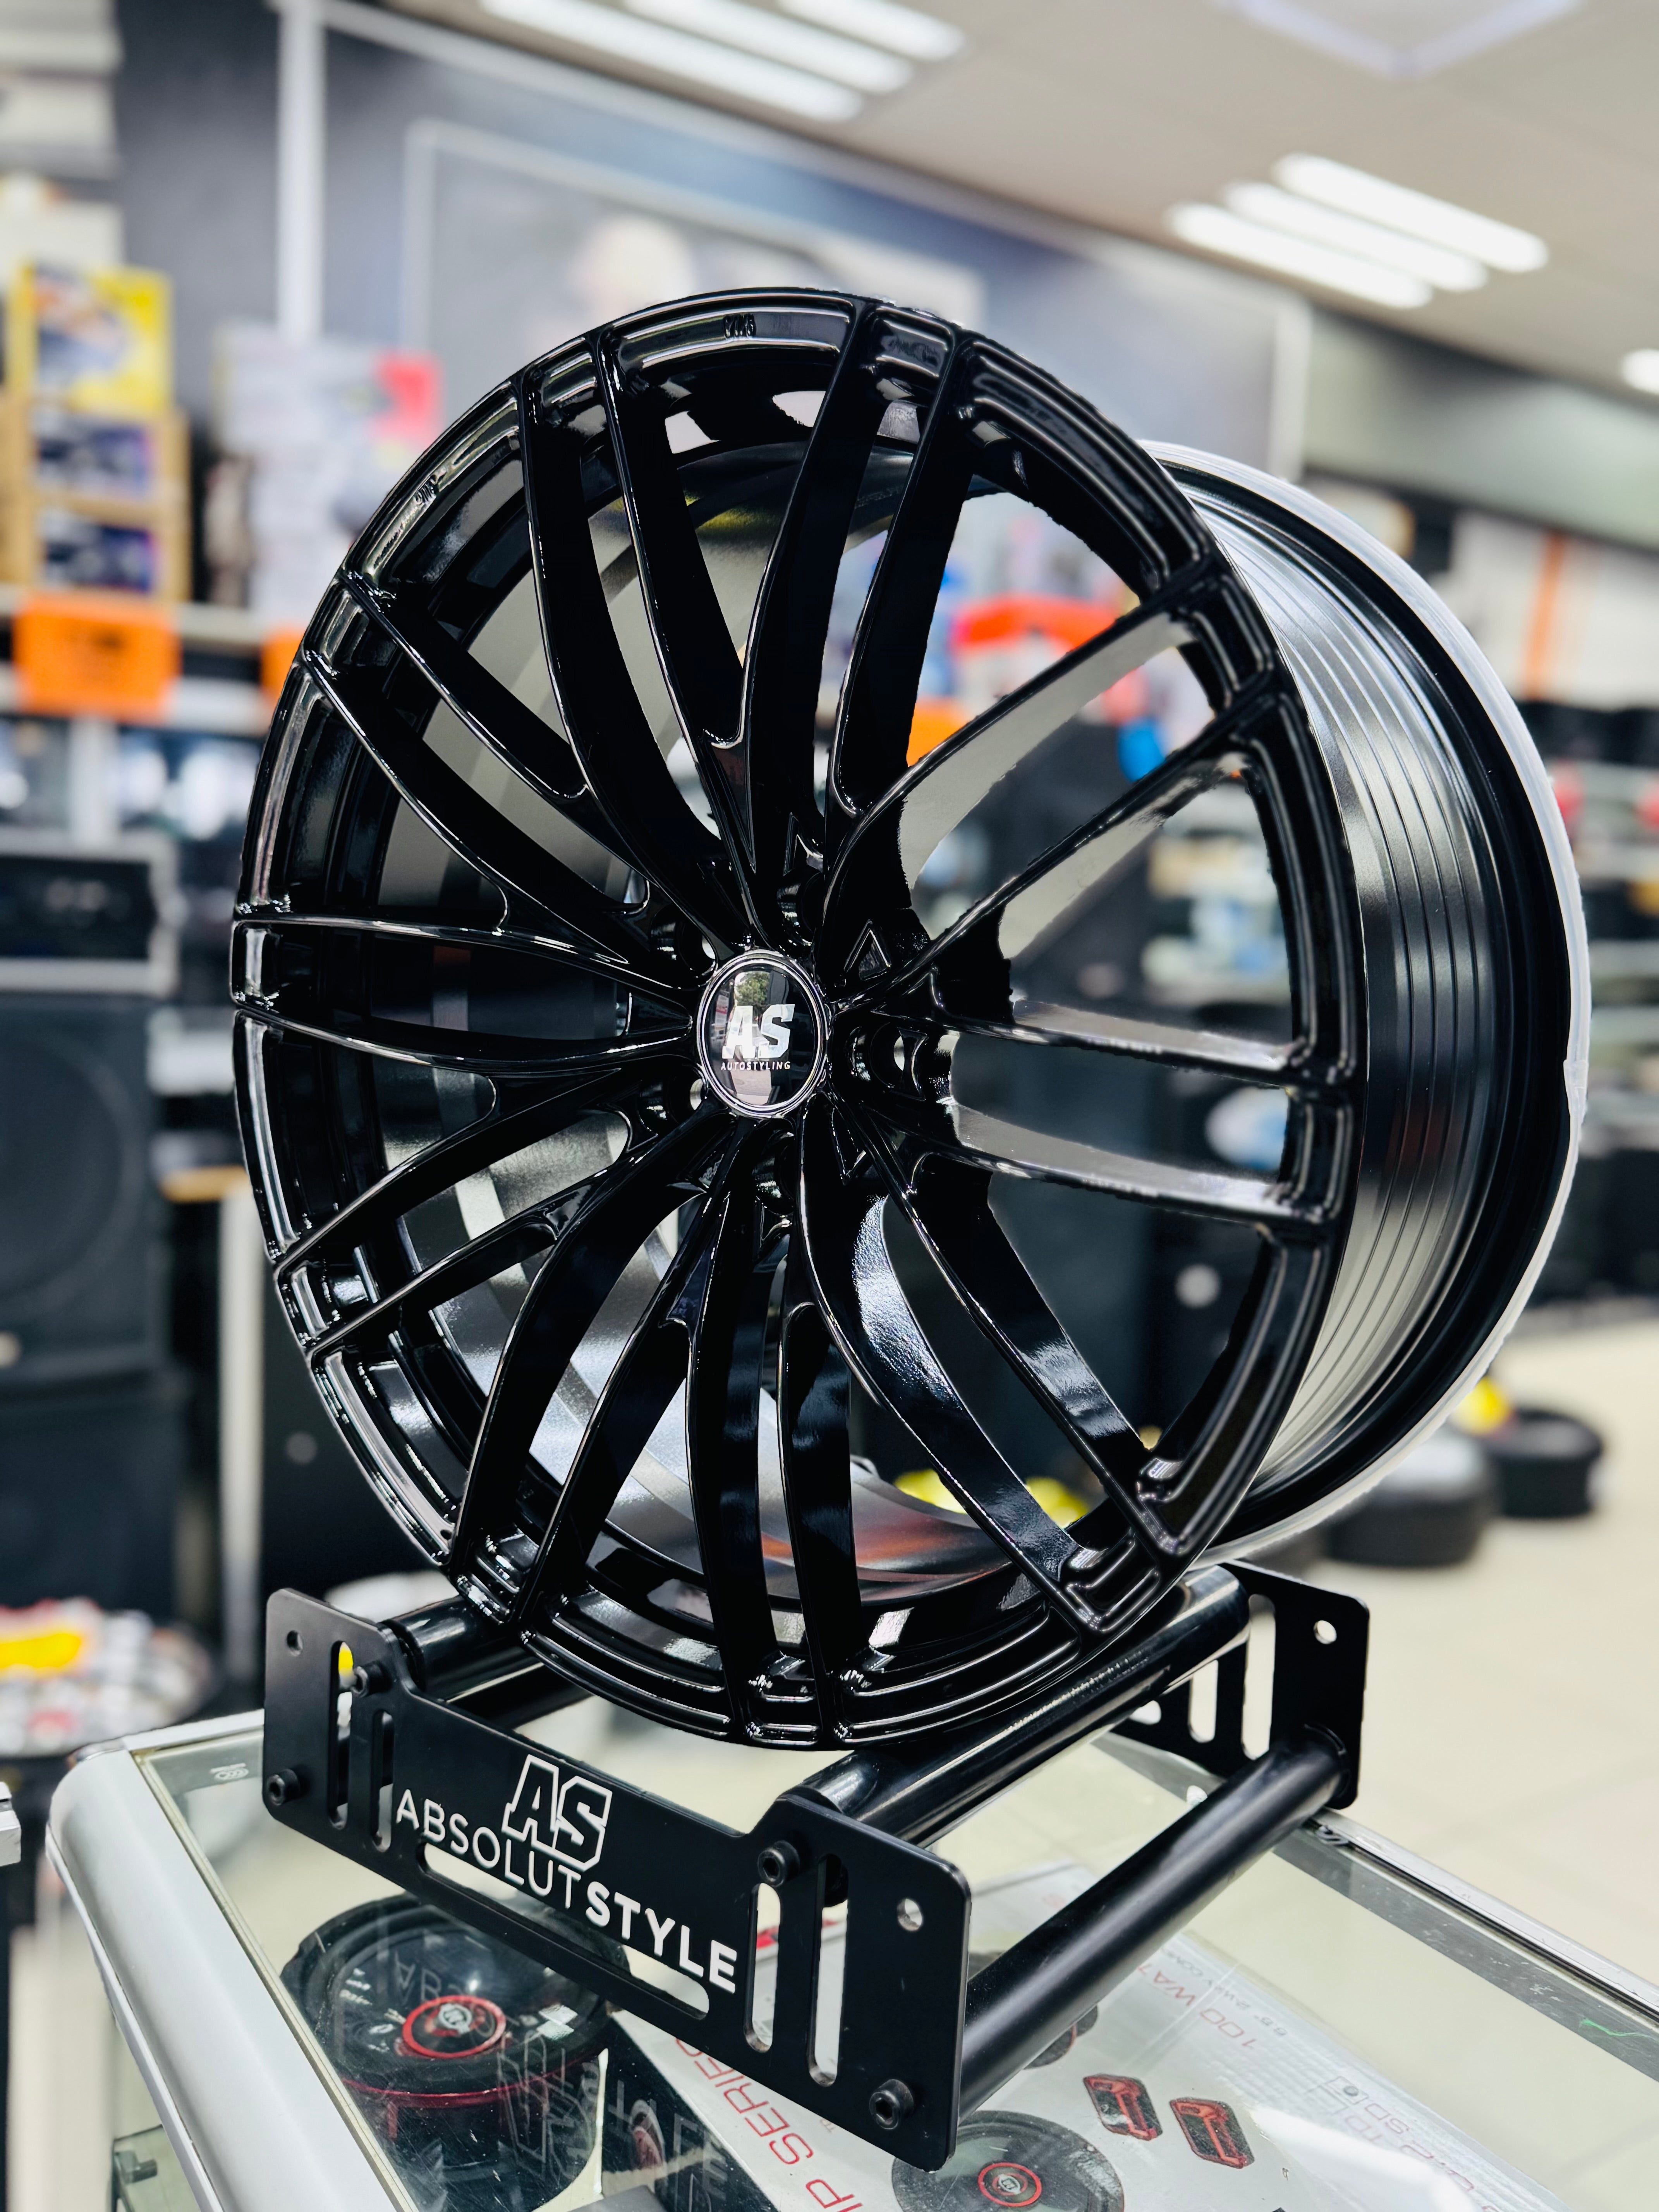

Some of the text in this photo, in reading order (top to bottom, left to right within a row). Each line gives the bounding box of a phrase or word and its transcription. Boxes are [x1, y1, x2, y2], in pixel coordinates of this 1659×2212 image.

[722, 1004, 795, 1060] AS
[720, 1061, 791, 1071] AUTOSTYLING
[501, 1754, 613, 1872] AS
[1200, 2008, 1257, 2049] 100
